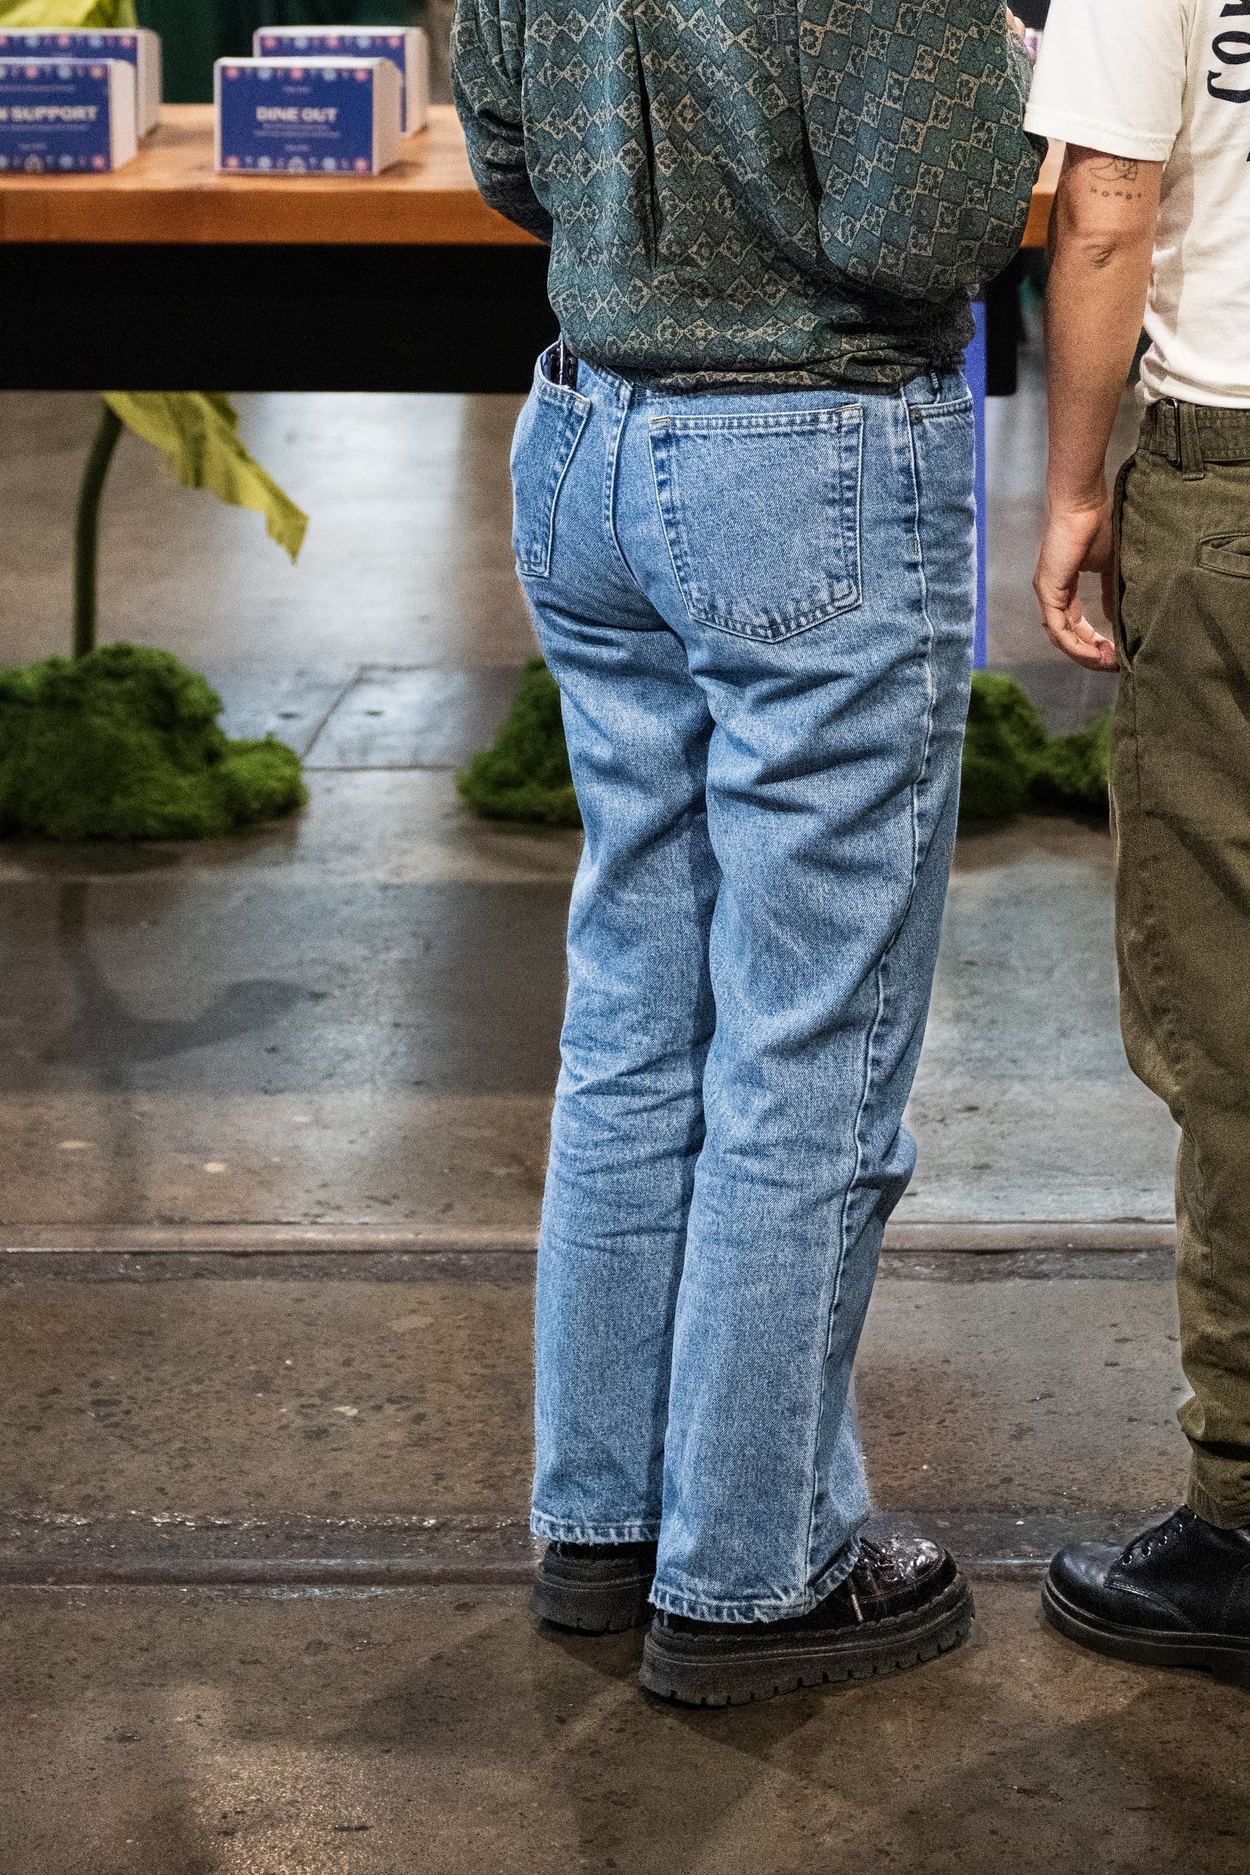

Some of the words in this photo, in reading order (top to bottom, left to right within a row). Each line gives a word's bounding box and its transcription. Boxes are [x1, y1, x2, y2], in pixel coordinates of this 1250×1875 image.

[11, 106, 97, 122] SUPPORT
[256, 106, 299, 123] DINE
[301, 106, 338, 123] OUT
